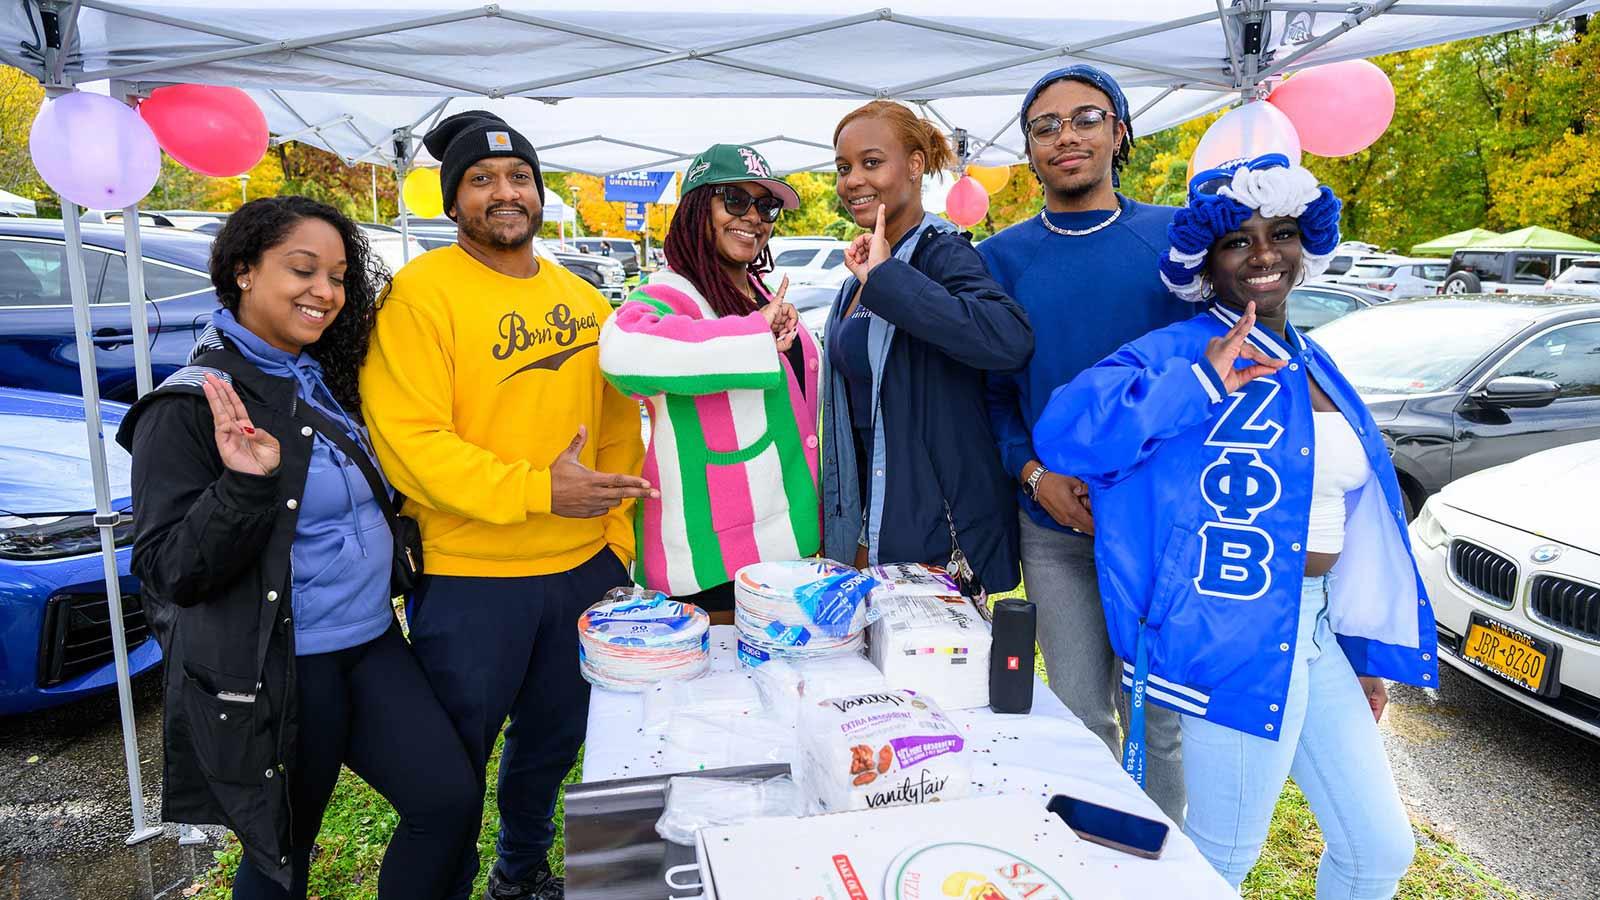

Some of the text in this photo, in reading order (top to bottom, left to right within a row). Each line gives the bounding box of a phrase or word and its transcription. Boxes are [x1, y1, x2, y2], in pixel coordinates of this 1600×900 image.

[609, 171, 648, 179] ACE
[609, 179, 656, 188] UNIVERSITY
[492, 310, 552, 360] Born
[1462, 655, 1538, 693] NEW ROCHELLE
[1505, 644, 1541, 678] 8260
[1134, 680, 1145, 708] 1920
[840, 715, 868, 733] EXTRA
[1127, 742, 1139, 771] Zeta
